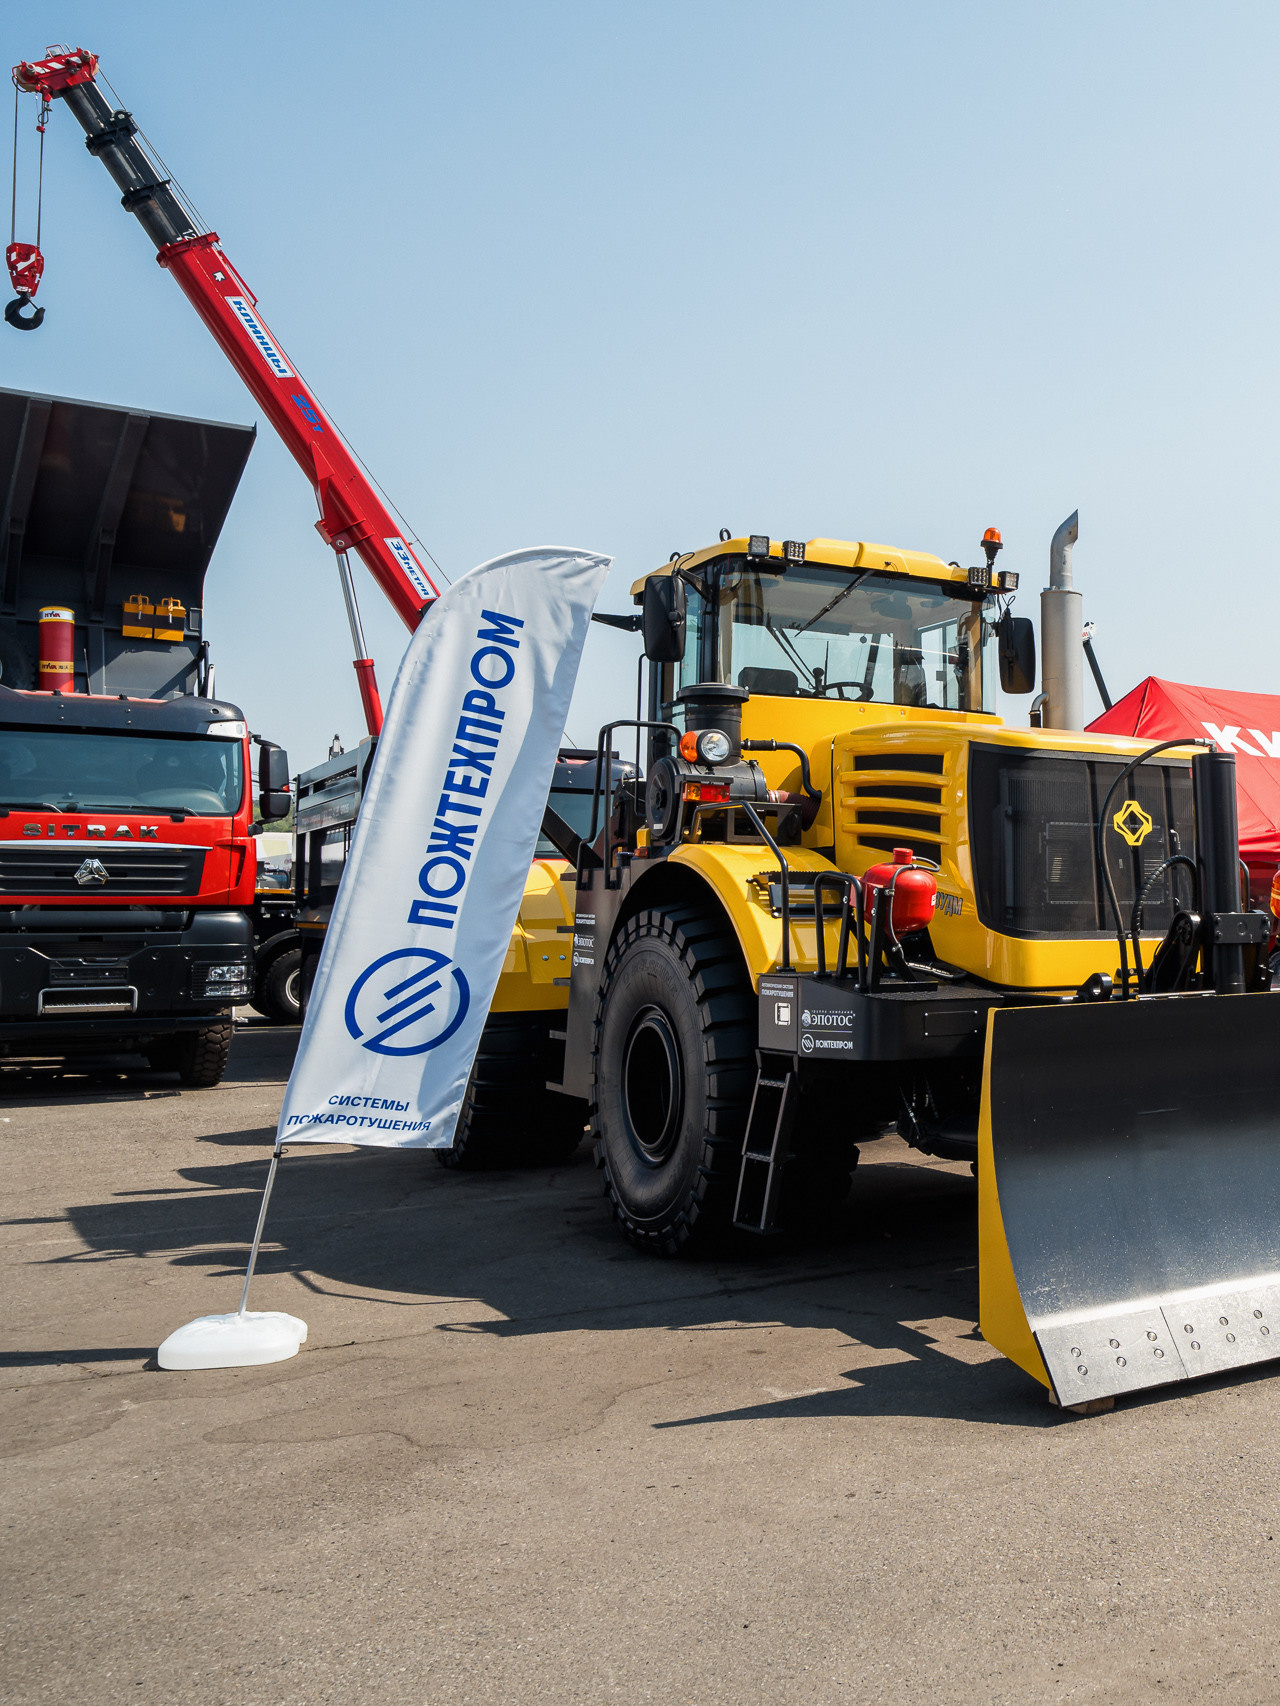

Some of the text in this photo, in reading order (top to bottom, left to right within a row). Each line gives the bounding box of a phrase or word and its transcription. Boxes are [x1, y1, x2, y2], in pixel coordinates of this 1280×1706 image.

[232, 300, 288, 374] КЛИНЦЫ
[407, 609, 525, 929] ПОЖТЕХПРОМ
[22, 823, 159, 839] SITRAK
[811, 1014, 853, 1027] ЭПОТОС
[815, 1040, 853, 1049] ПОЖТЕХПРОМ
[328, 1095, 410, 1112] СИСТЕМЫ
[286, 1113, 431, 1131] ПОЖАРОТУШЕНИЯ
